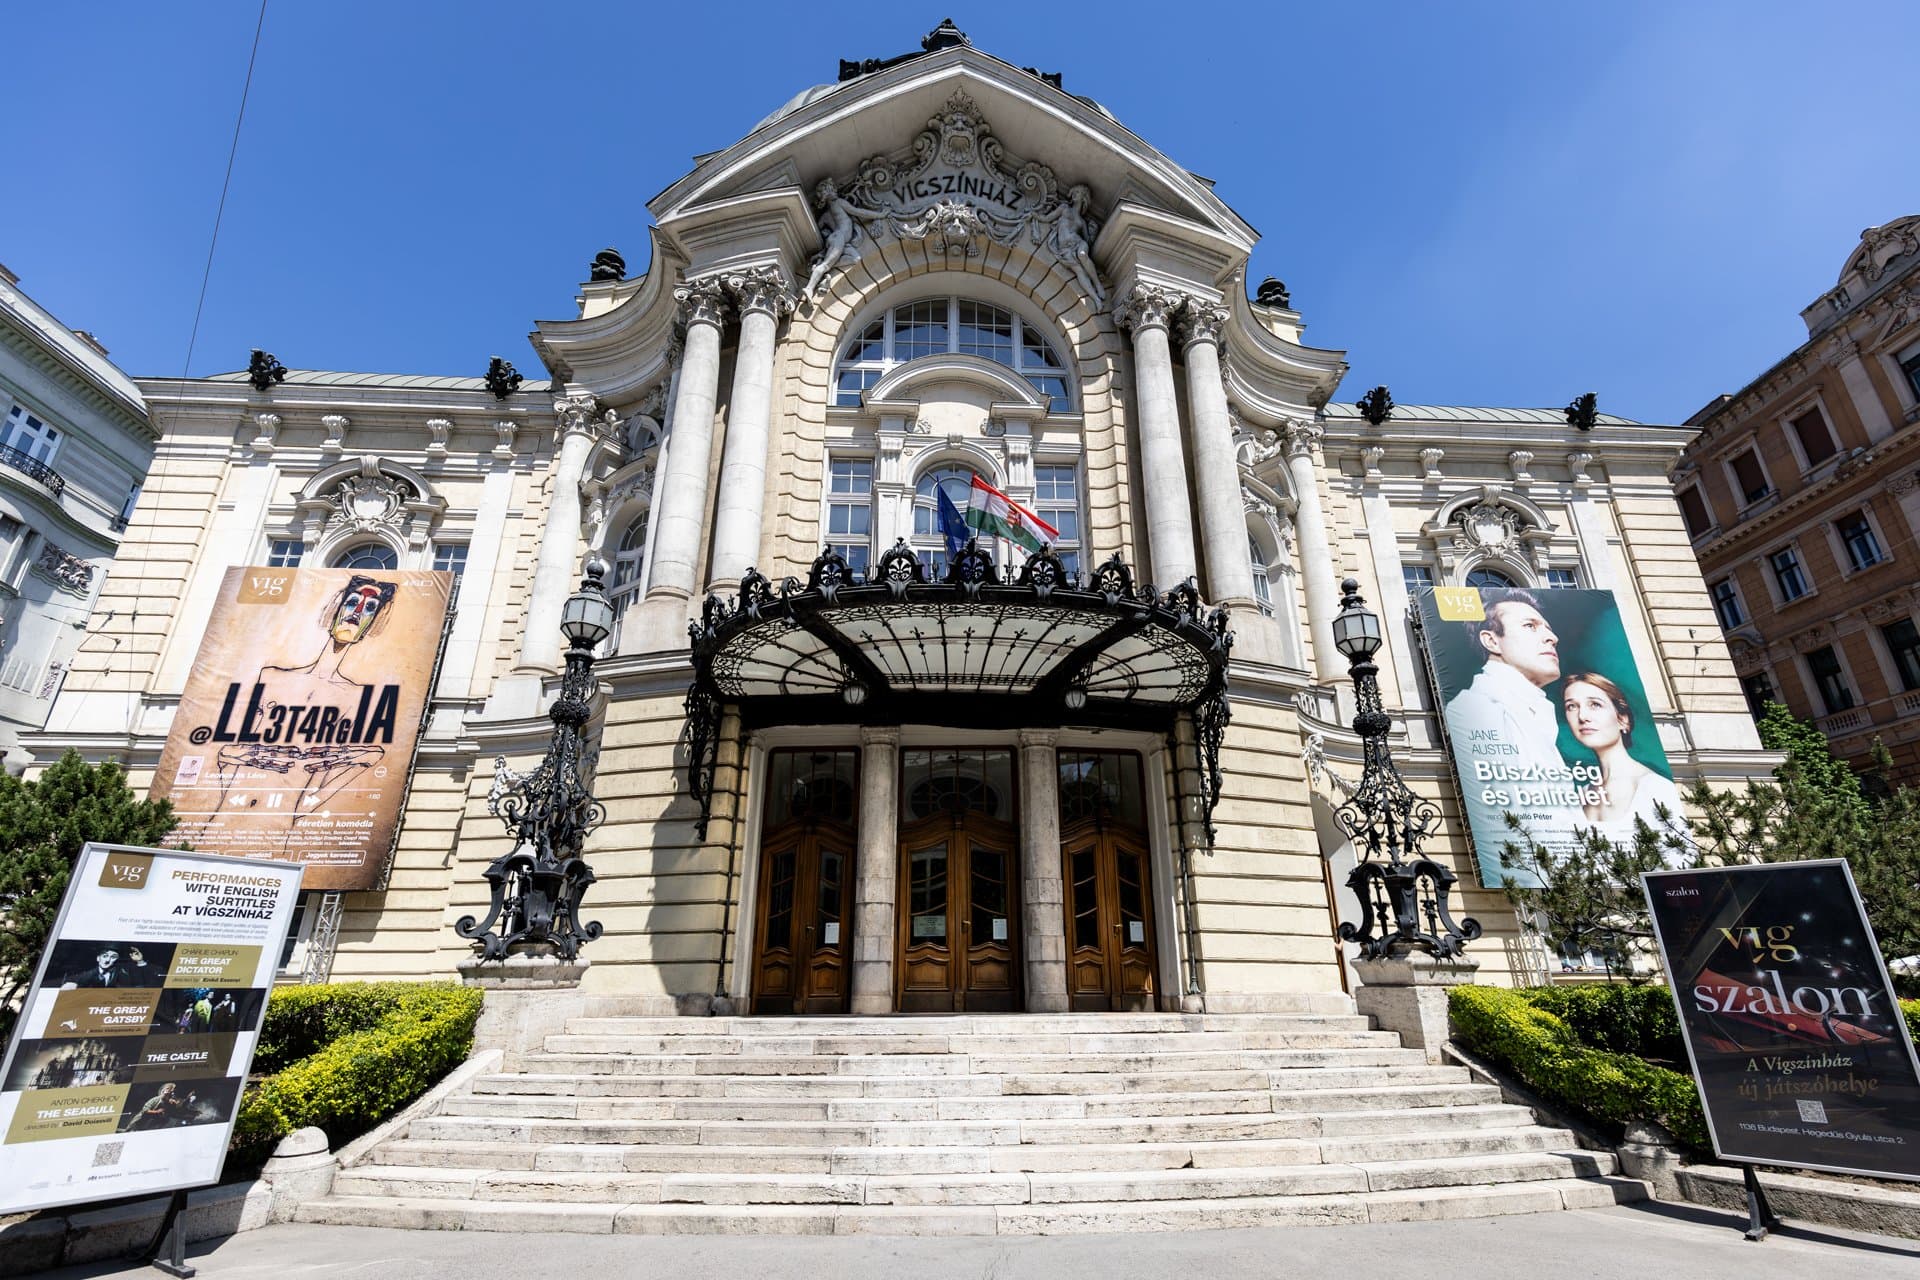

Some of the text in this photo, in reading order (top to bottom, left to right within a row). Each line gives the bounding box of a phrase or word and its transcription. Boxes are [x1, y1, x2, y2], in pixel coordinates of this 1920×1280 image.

[1468, 729, 1499, 741] JANE
[1471, 744, 1520, 755] AUSTEN
[1474, 760, 1604, 786] Büszkeség
[1481, 784, 1510, 806] és
[335, 819, 374, 828] komédia
[172, 870, 282, 887] PERFORMANCES
[185, 883, 279, 898] WITH ENGLISH
[1665, 887, 1700, 897] szalon
[206, 895, 276, 909] SURTITLES
[172, 905, 191, 915] AT
[179, 957, 232, 965] THE GREAT
[175, 966, 223, 974] DICTATOR
[1693, 970, 1879, 1016] szalon
[88, 1006, 150, 1015] THE GREAT
[103, 1016, 147, 1024] GATSBY
[147, 1051, 209, 1062] THE CASTLE
[1747, 1058, 1760, 1072] A
[1738, 1073, 1879, 1101] új játszóhelye
[50, 1095, 121, 1106] ANTON CHEKHOV
[36, 1105, 115, 1119] THE SEAGULL
[1845, 1132, 1872, 1142] Gyula
[1873, 1135, 1896, 1144] utca
